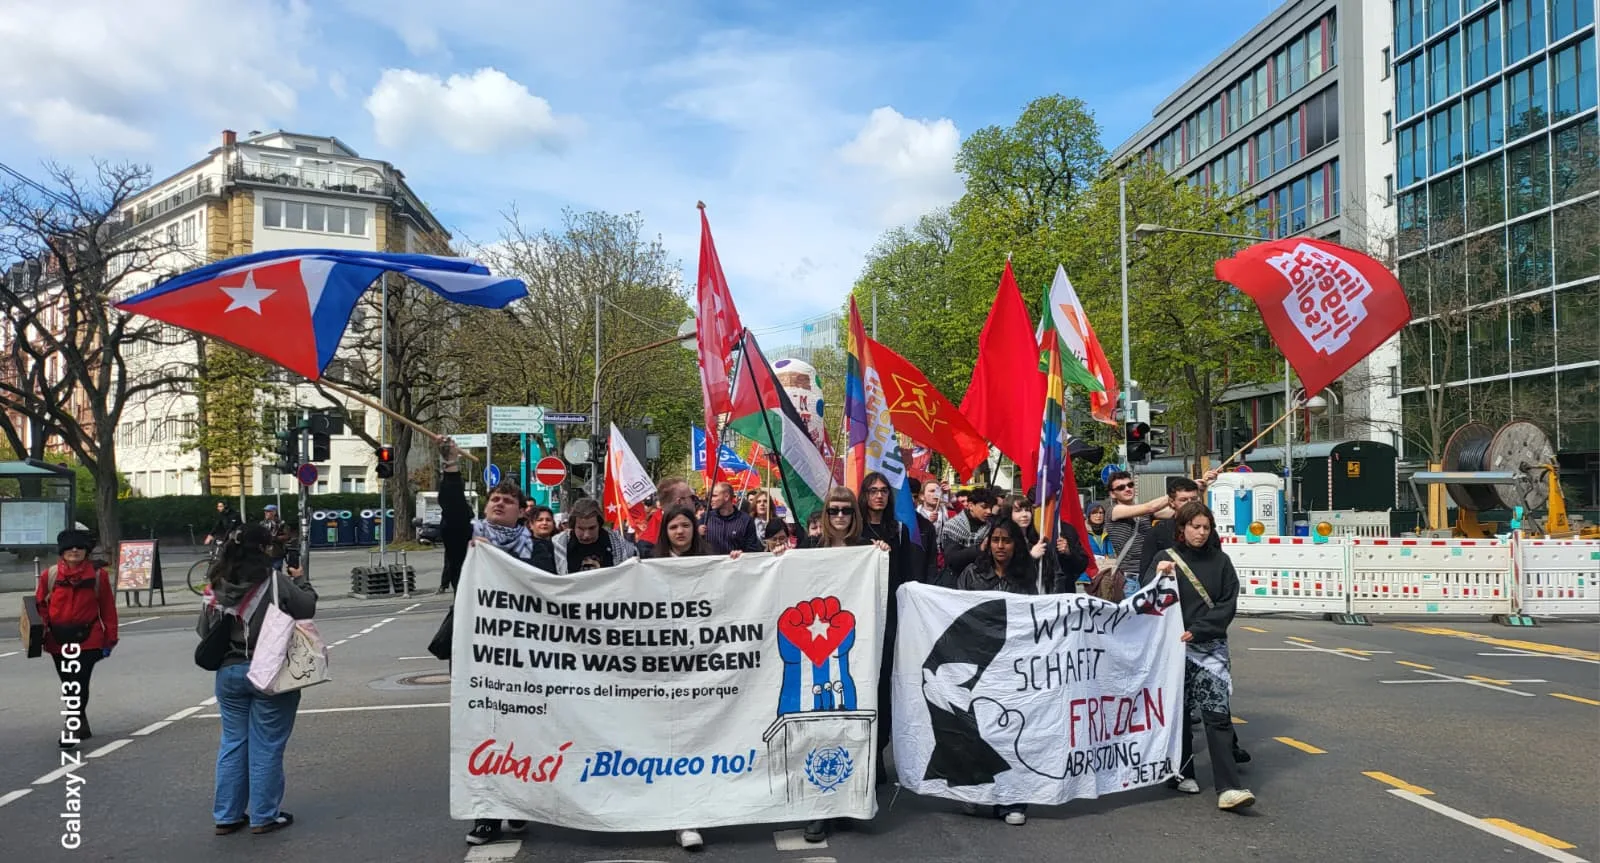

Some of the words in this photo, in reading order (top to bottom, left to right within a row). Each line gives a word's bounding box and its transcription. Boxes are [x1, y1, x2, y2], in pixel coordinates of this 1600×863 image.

[477, 588, 542, 613] WENN
[546, 599, 581, 620] DIE
[585, 600, 668, 621] HUNDE
[671, 599, 713, 618] DES
[474, 616, 602, 647] IMPERIUMS
[606, 627, 695, 650] BELLEN,
[699, 622, 764, 645] DANN
[472, 644, 524, 669] WEIL
[529, 650, 576, 671] WIR
[582, 652, 638, 674] WAS
[641, 651, 762, 674] BEWEGEN!
[469, 676, 483, 689] Si
[484, 678, 522, 693] ladran
[523, 680, 543, 694] los
[545, 684, 591, 698] perros
[593, 683, 614, 697] del
[615, 684, 669, 701] imperio,
[671, 684, 689, 700] ¡es
[692, 684, 739, 701] porque
[467, 698, 547, 717] cabalgamos!
[467, 738, 531, 783] Cuba
[529, 740, 573, 783] sí
[580, 751, 704, 784] ¡Bloqueo
[711, 749, 756, 776] no!
